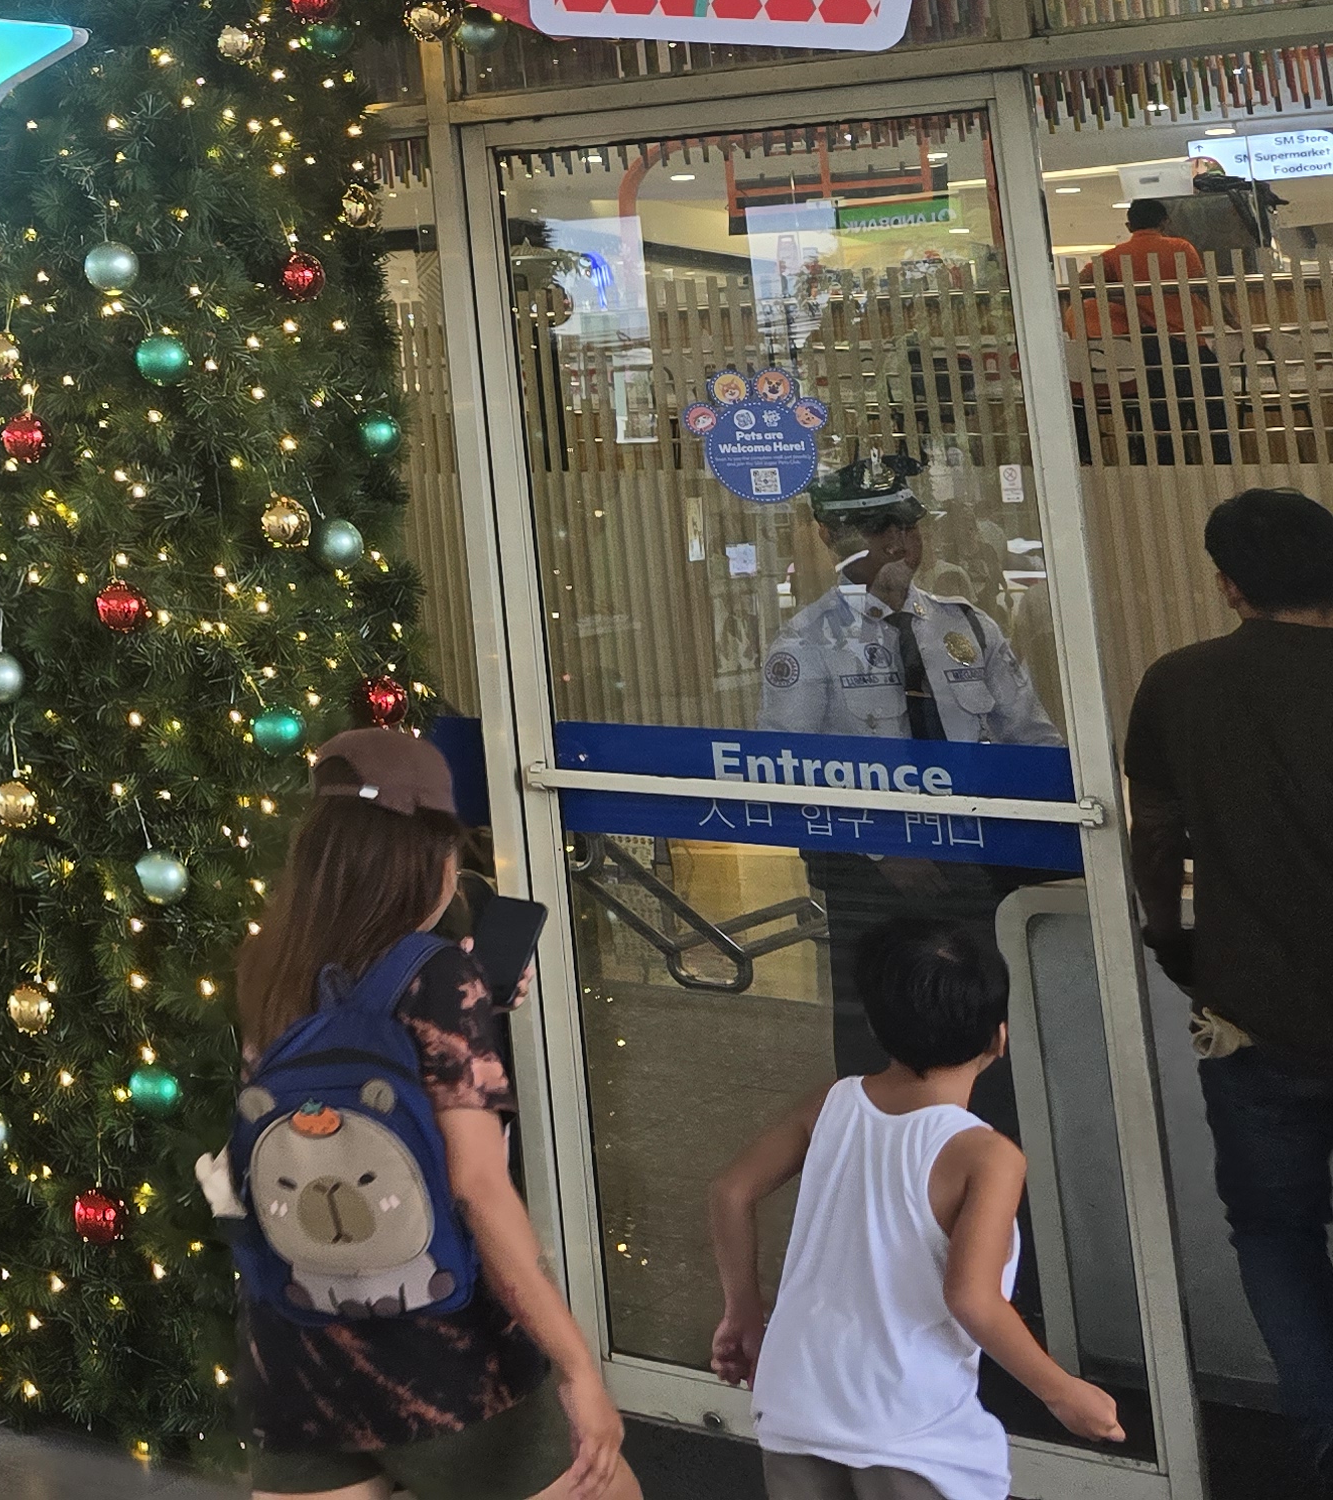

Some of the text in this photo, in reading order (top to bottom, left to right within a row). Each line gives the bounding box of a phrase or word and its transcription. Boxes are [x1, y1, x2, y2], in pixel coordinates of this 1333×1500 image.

[1274, 134, 1329, 146] SM Store
[1254, 147, 1331, 162] Supermarket
[1273, 162, 1333, 174] Foodcourt
[735, 430, 784, 441] Pets are
[718, 440, 806, 454] Welcome Here!
[711, 741, 953, 796] Entrance
